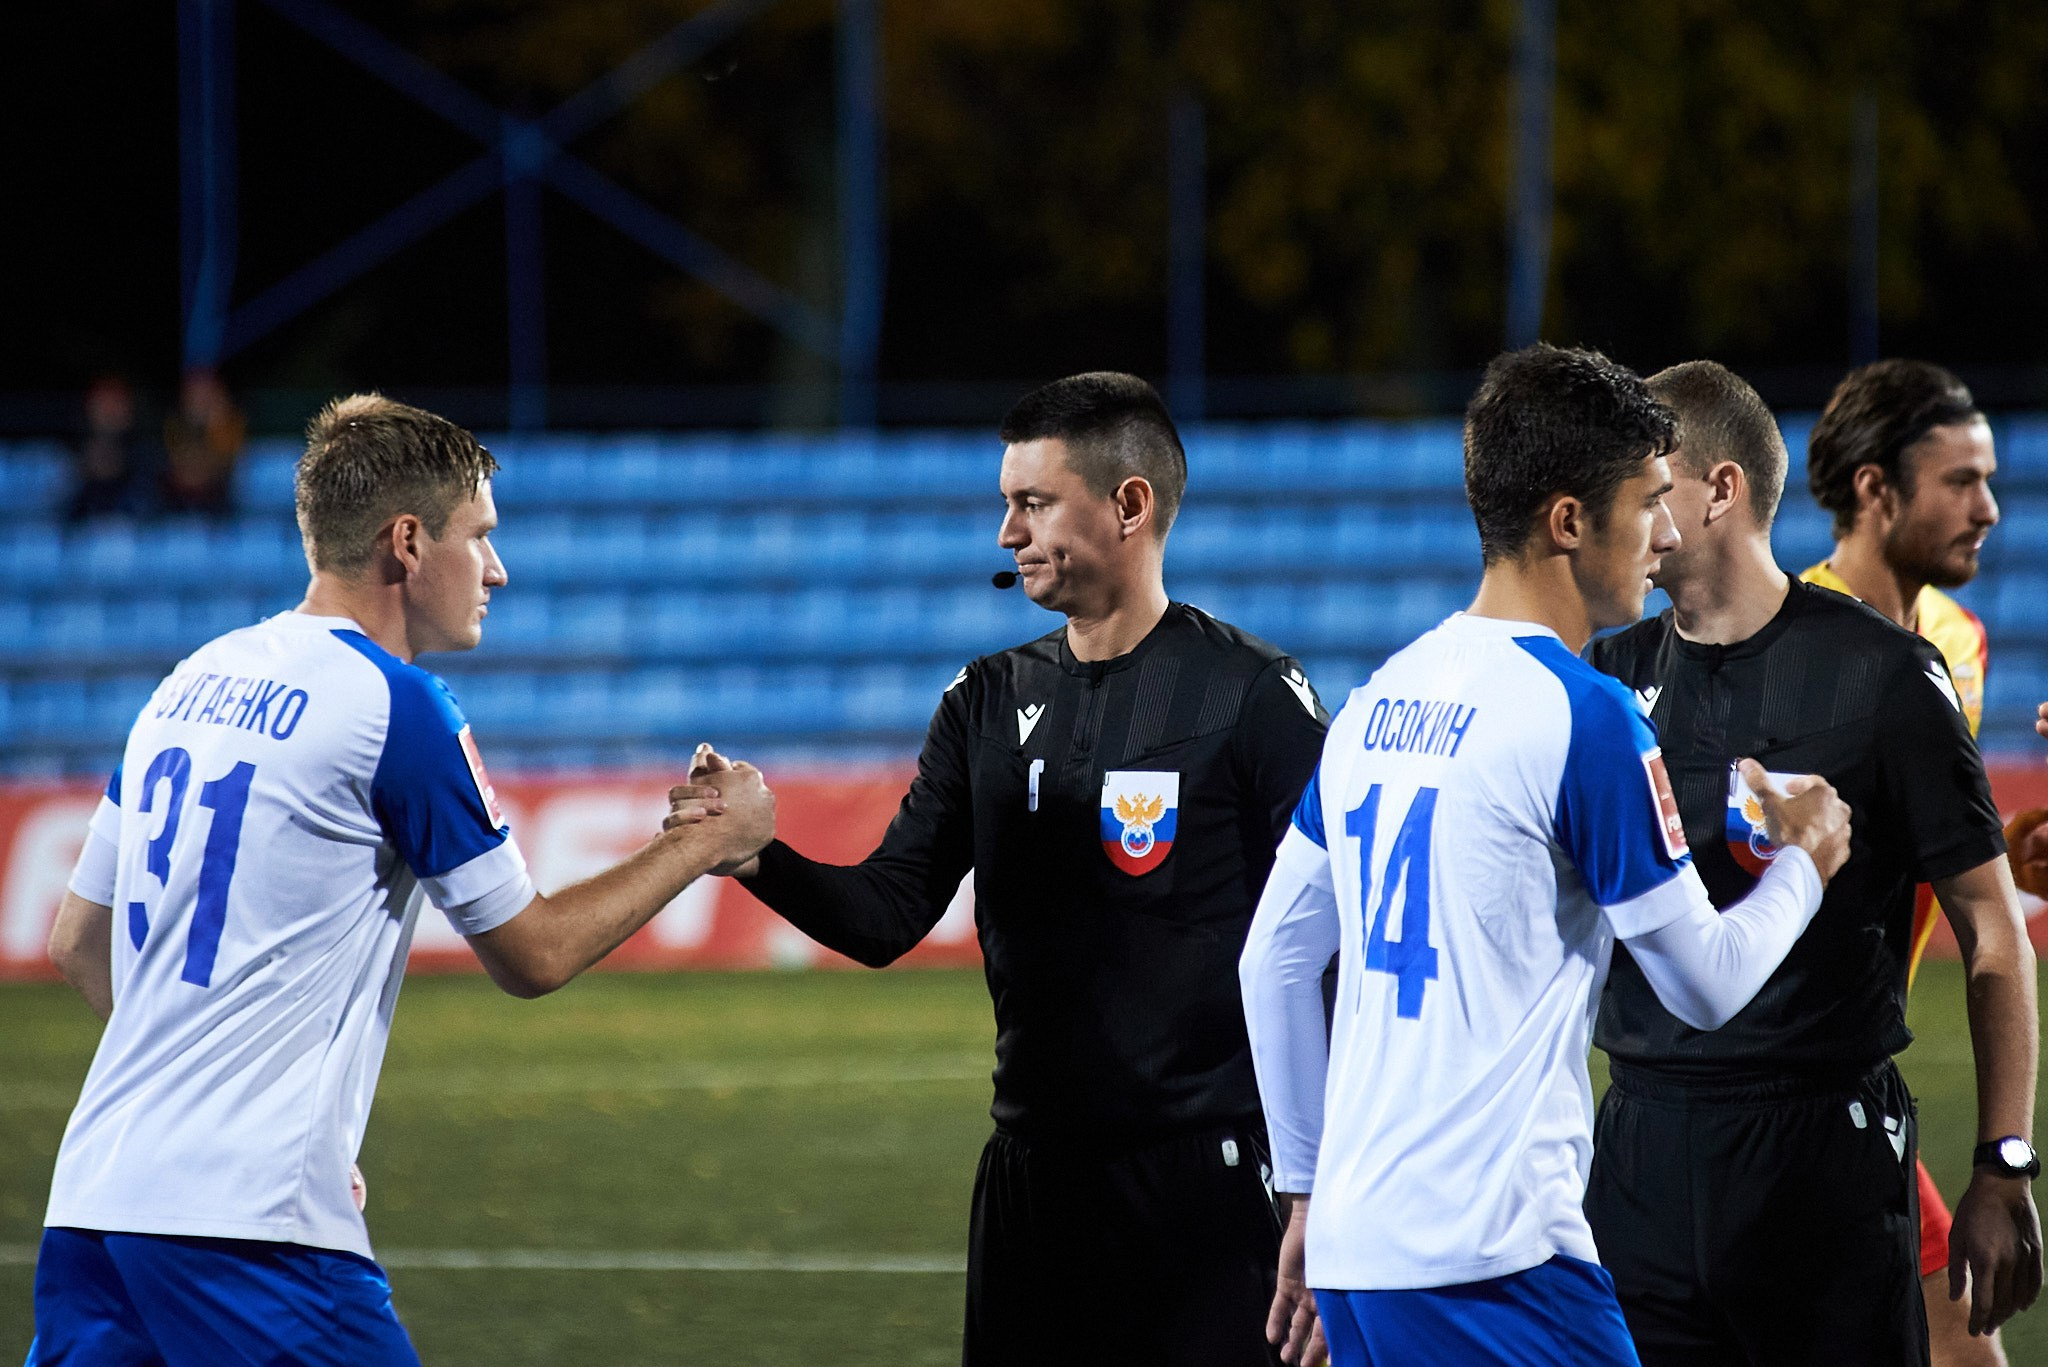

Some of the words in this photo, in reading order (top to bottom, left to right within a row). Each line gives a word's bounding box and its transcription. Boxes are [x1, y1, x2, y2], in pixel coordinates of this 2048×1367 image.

[1364, 698, 1477, 758] ОСОКИН
[128, 747, 257, 988] 31
[1345, 783, 1439, 1020] 14
